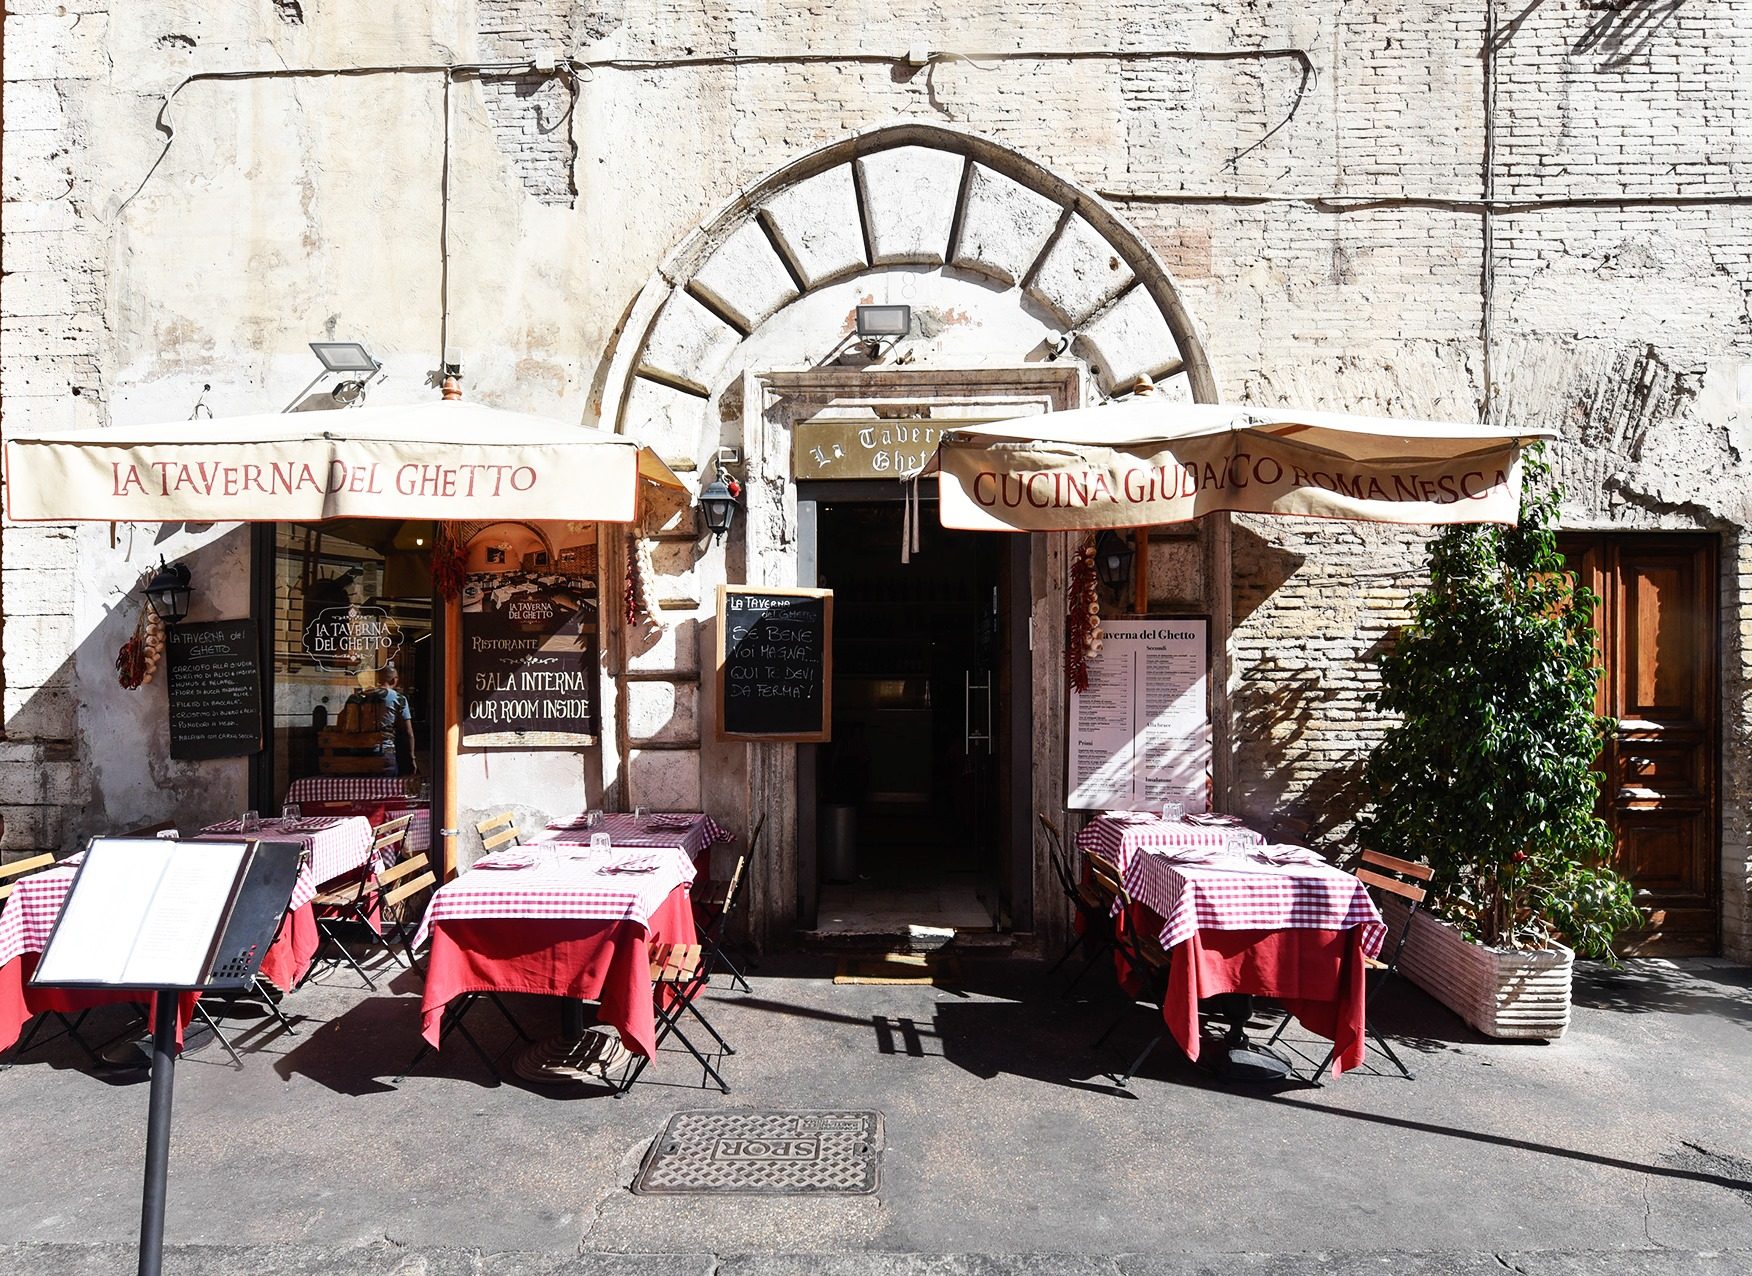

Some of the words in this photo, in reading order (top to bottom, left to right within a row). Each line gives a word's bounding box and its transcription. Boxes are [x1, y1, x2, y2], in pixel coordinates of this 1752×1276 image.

[809, 444, 845, 469] La
[112, 461, 149, 496] LA
[152, 461, 324, 496] TAVERNA
[328, 459, 383, 494] DEL
[395, 463, 537, 497] GHETTO
[973, 471, 1119, 508] CUCINA
[1124, 454, 1283, 503] GIUDAICO
[1290, 464, 1514, 505] ROMANESCA
[518, 602, 553, 611] TAVERNA
[731, 596, 743, 608] LA
[745, 596, 791, 609] TAVERNA
[508, 611, 521, 620] DEL
[522, 611, 554, 619] GHETTO
[169, 631, 181, 644] LA
[181, 630, 225, 644] TAVERNA
[316, 623, 330, 637] LA
[330, 622, 391, 637] TAVERNA
[732, 625, 759, 641] SE
[766, 626, 813, 643] BENE
[1103, 632, 1138, 640] averna
[1140, 629, 1156, 640] del
[1158, 629, 1196, 640] Ghetto
[189, 644, 231, 656] GHETTO
[315, 637, 337, 651] DEL
[339, 637, 392, 651] GHETTO
[471, 636, 538, 652] RISTORANTE
[730, 666, 758, 679] QUI
[785, 666, 814, 681] DEVI
[476, 671, 517, 691] SALA
[521, 671, 585, 694] INTERNA
[730, 684, 751, 698] DA
[470, 699, 498, 723] OUR
[500, 699, 539, 723] ROOM
[543, 699, 592, 719] INSIDE
